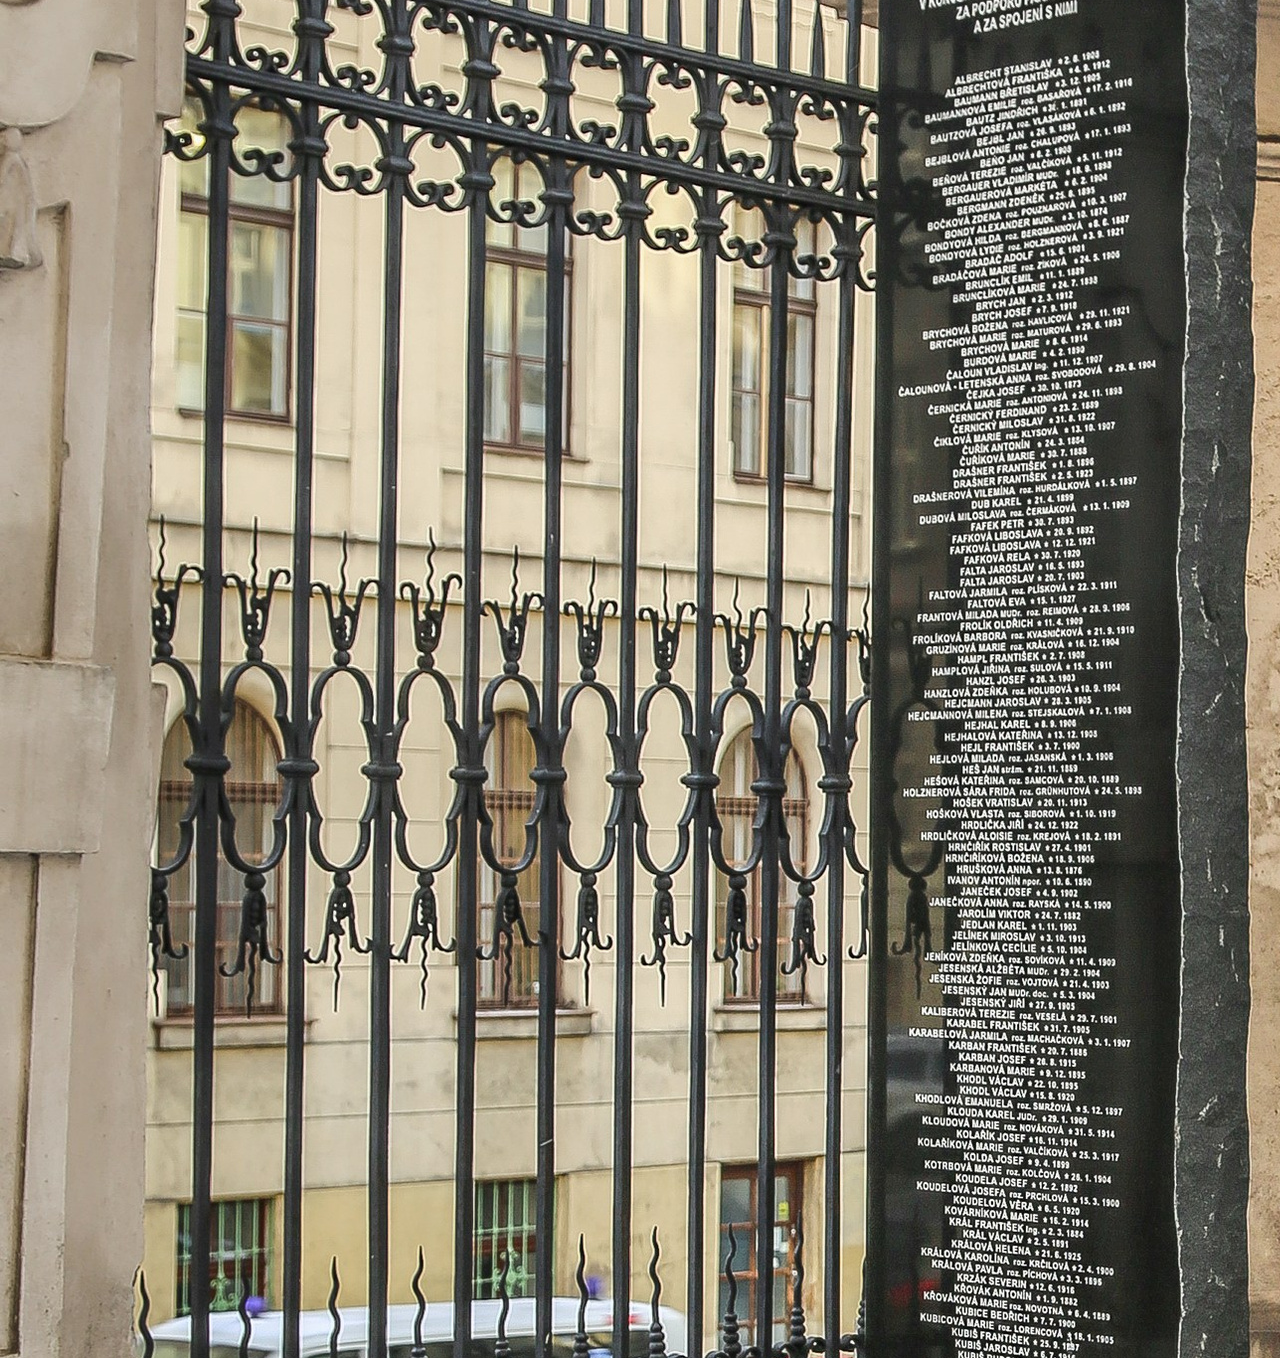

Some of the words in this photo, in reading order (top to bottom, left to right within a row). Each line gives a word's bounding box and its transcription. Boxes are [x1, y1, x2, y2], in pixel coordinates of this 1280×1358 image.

[955, 4, 971, 20] ZA
[973, 19, 982, 34] A
[982, 16, 998, 32] ZA
[998, 3, 1044, 29] SPOJENÍ
[1044, 4, 1053, 19] S
[1054, 0, 1078, 17] NIMI
